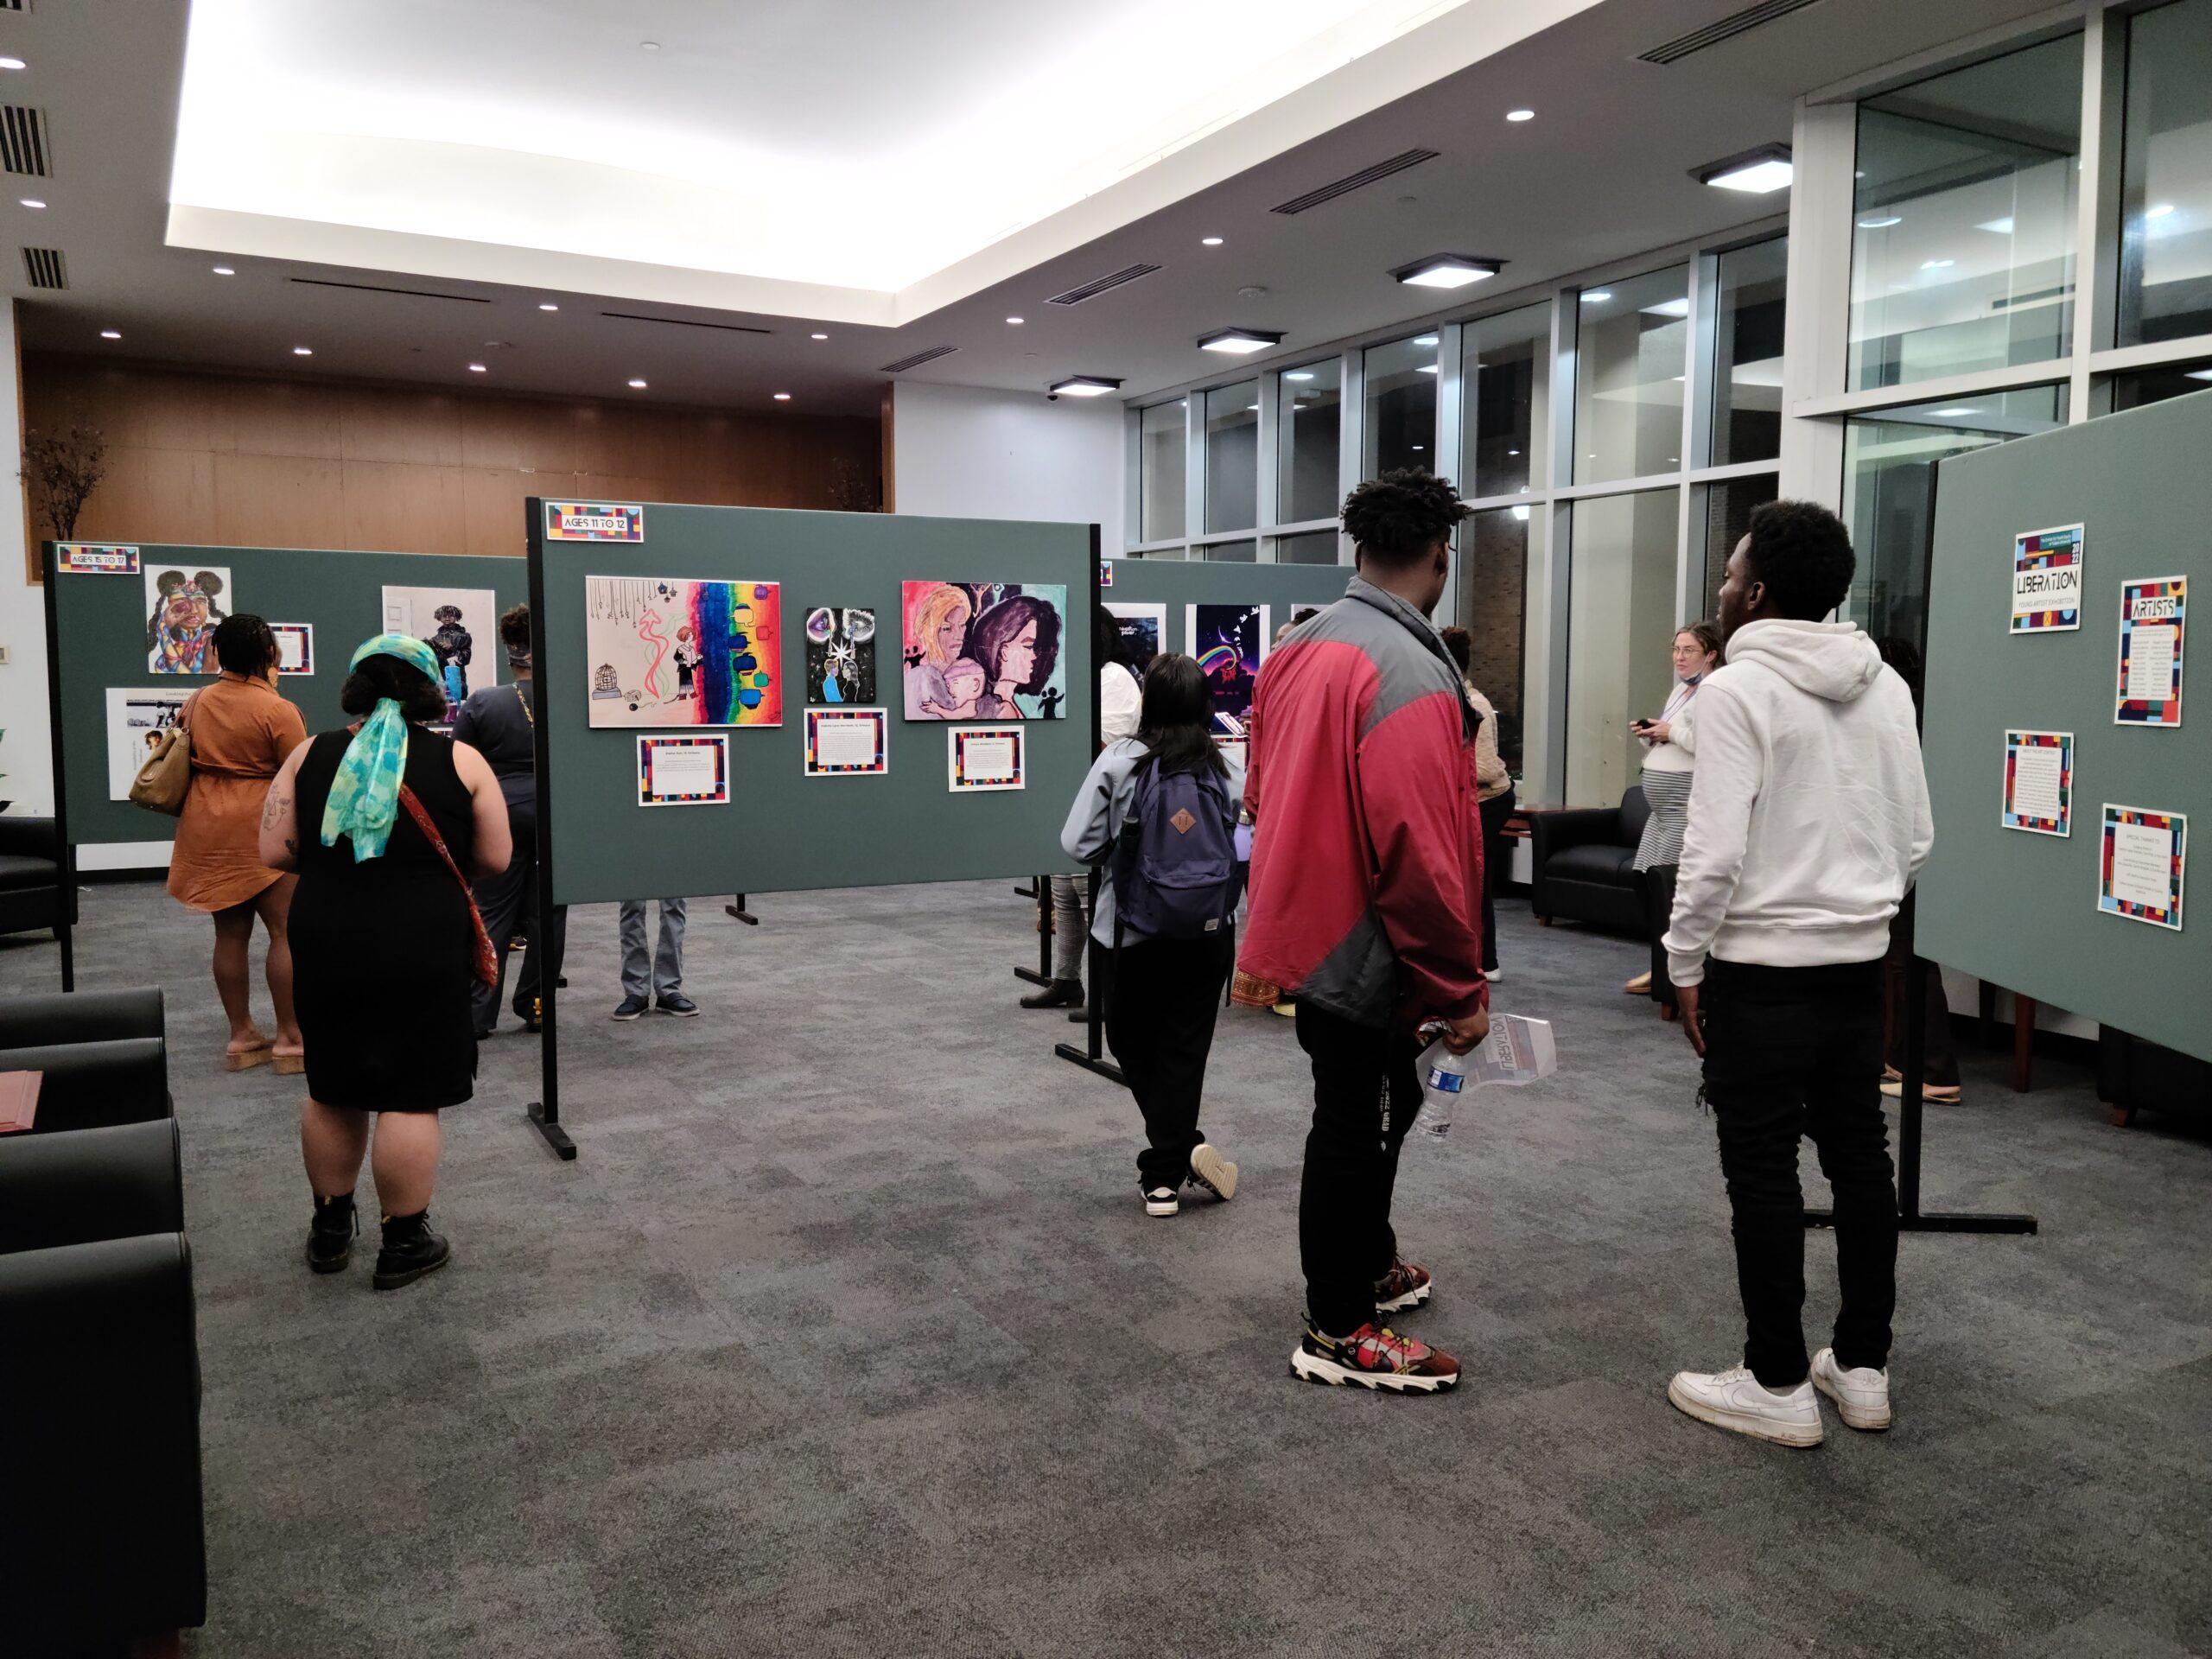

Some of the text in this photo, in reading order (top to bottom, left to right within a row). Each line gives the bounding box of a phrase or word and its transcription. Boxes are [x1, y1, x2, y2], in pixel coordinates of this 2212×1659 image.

[600, 519, 613, 528] TO
[2072, 543, 2080, 553] 20
[2071, 554, 2079, 563] 22
[2017, 570, 2077, 594] LIBERATION
[2048, 596, 2075, 606] EXHIBITION
[2133, 600, 2174, 617] ARTISTS
[1382, 1111, 1390, 1131] GRAD
